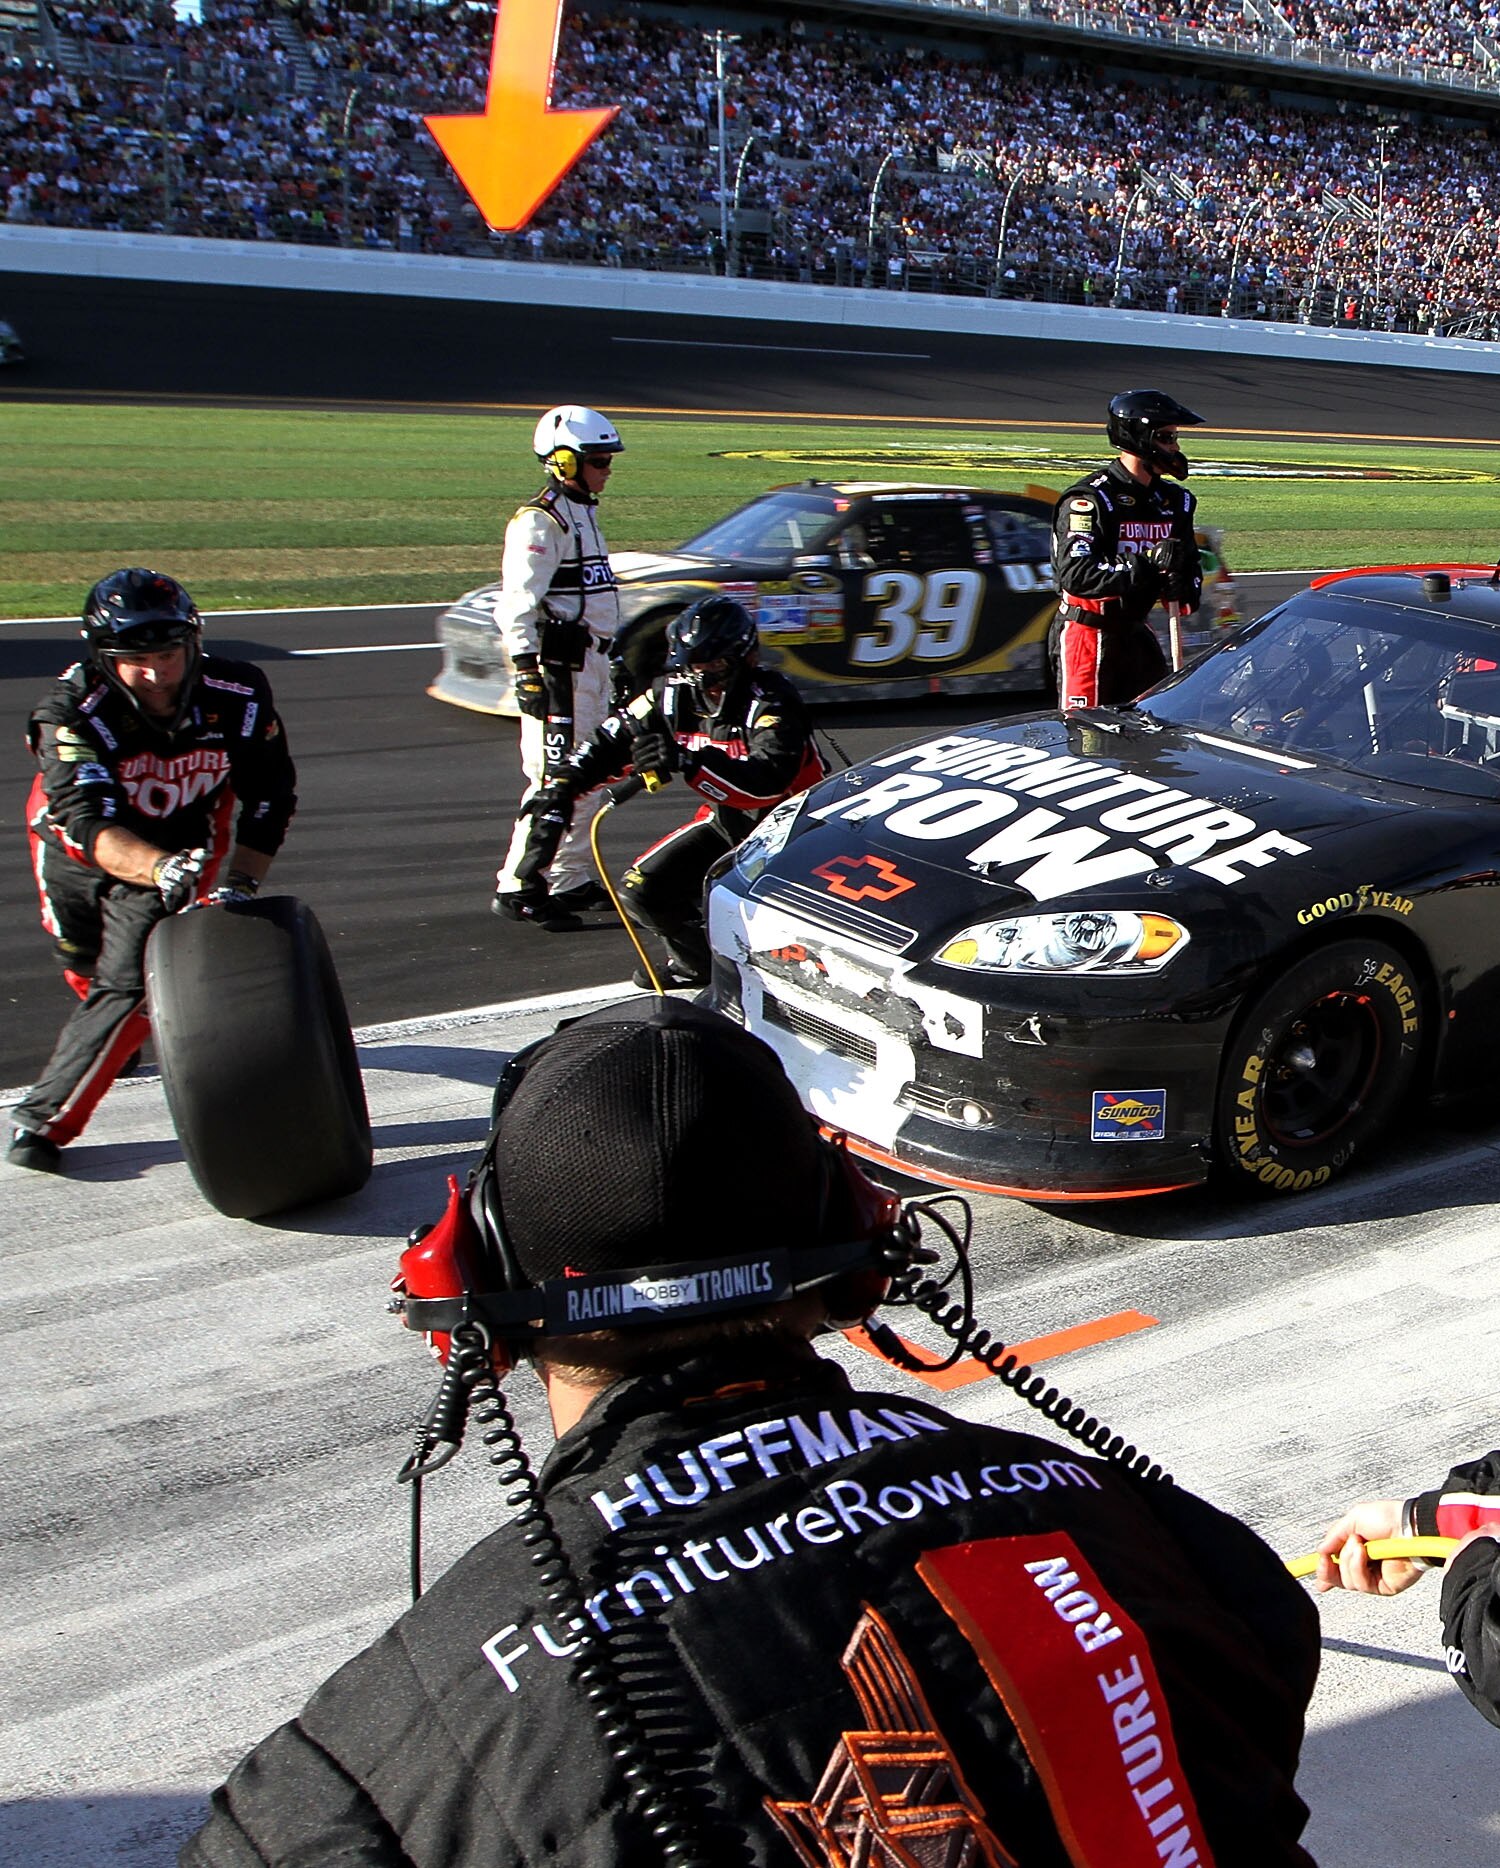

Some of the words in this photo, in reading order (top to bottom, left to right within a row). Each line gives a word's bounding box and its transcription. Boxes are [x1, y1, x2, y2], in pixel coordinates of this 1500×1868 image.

[849, 568, 988, 668] 39
[806, 771, 1161, 903] ROW
[870, 735, 1315, 887] FURNITURE
[1354, 974, 1376, 987] LF
[1363, 958, 1377, 976] 58
[1373, 962, 1419, 1035] EAGLE
[1099, 1105, 1160, 1118] SUNOCO
[566, 1282, 632, 1322] RACIN
[632, 1281, 692, 1302] HOBBY
[590, 1407, 948, 1532] HUFFMAN
[479, 1456, 1103, 1694] FurnitureRow.com
[1023, 1555, 1124, 1654] ROW
[1096, 1653, 1201, 1868] NITURE
